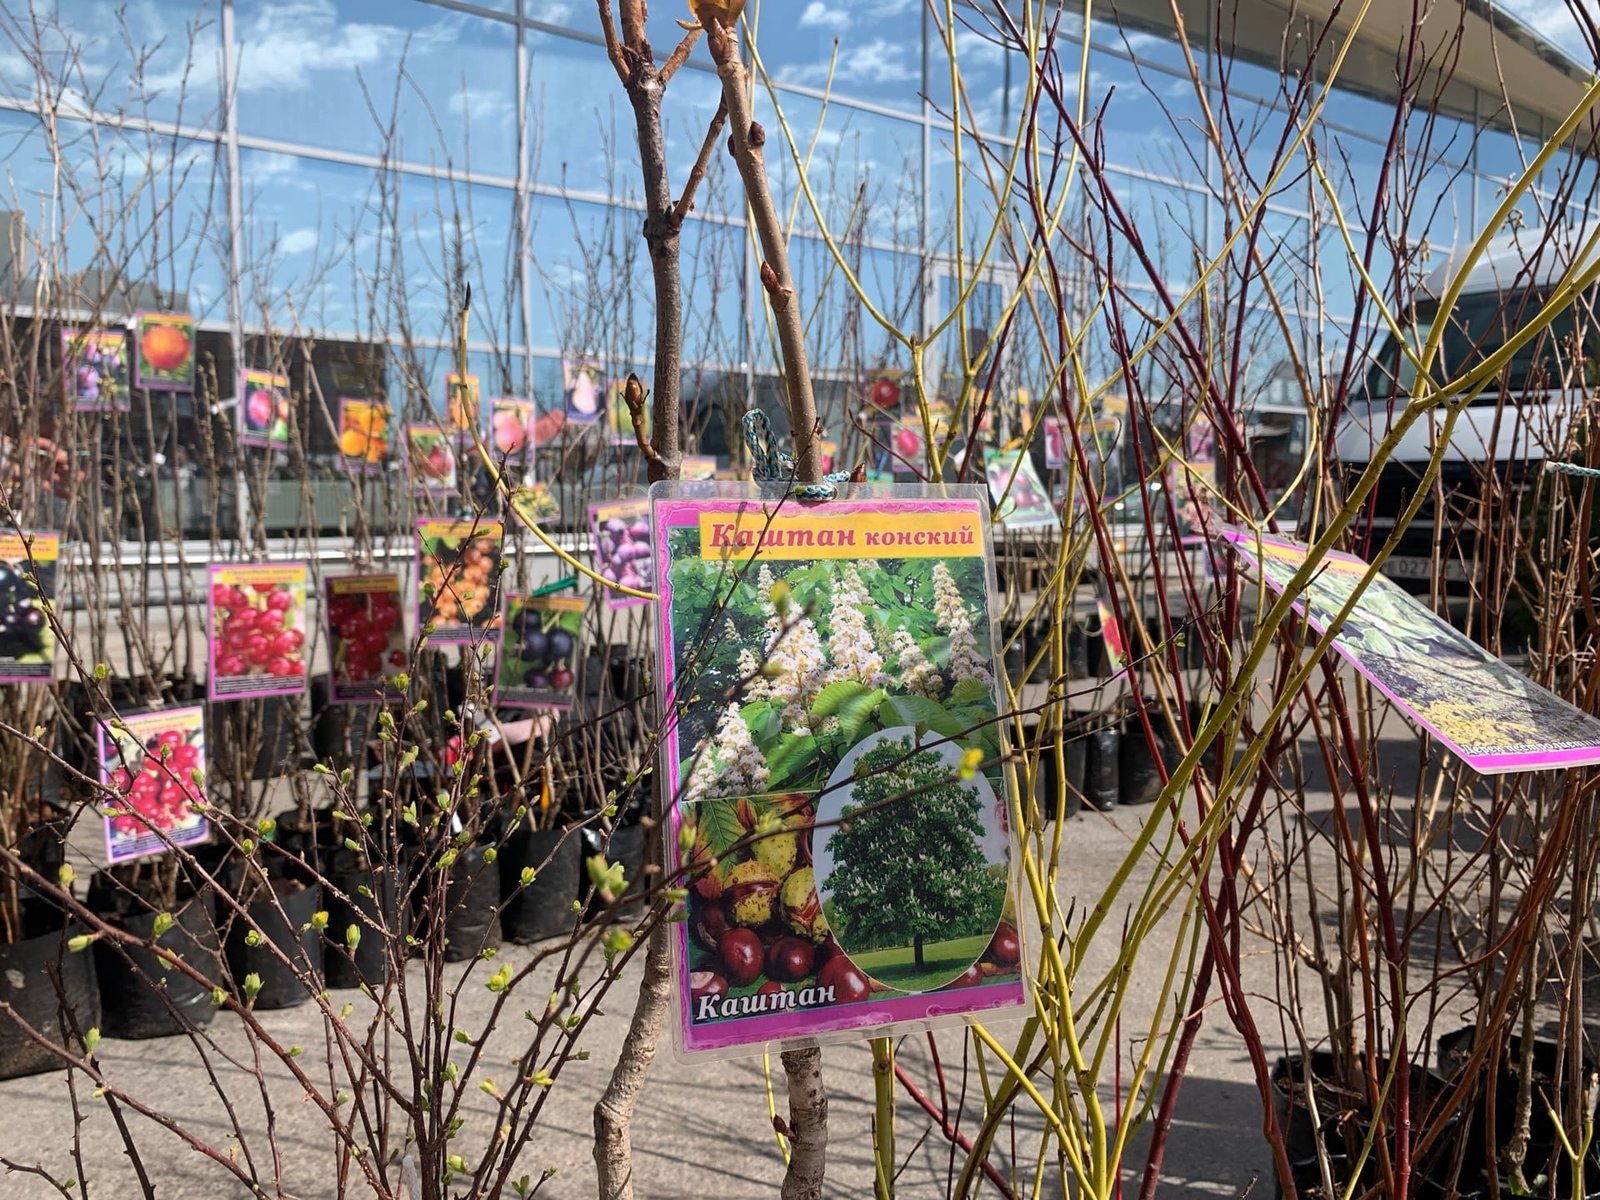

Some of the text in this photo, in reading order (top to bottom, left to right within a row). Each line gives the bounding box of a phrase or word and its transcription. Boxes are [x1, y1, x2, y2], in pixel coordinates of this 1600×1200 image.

[709, 523, 975, 548] Каштан конский
[695, 984, 837, 1021] Каштан
